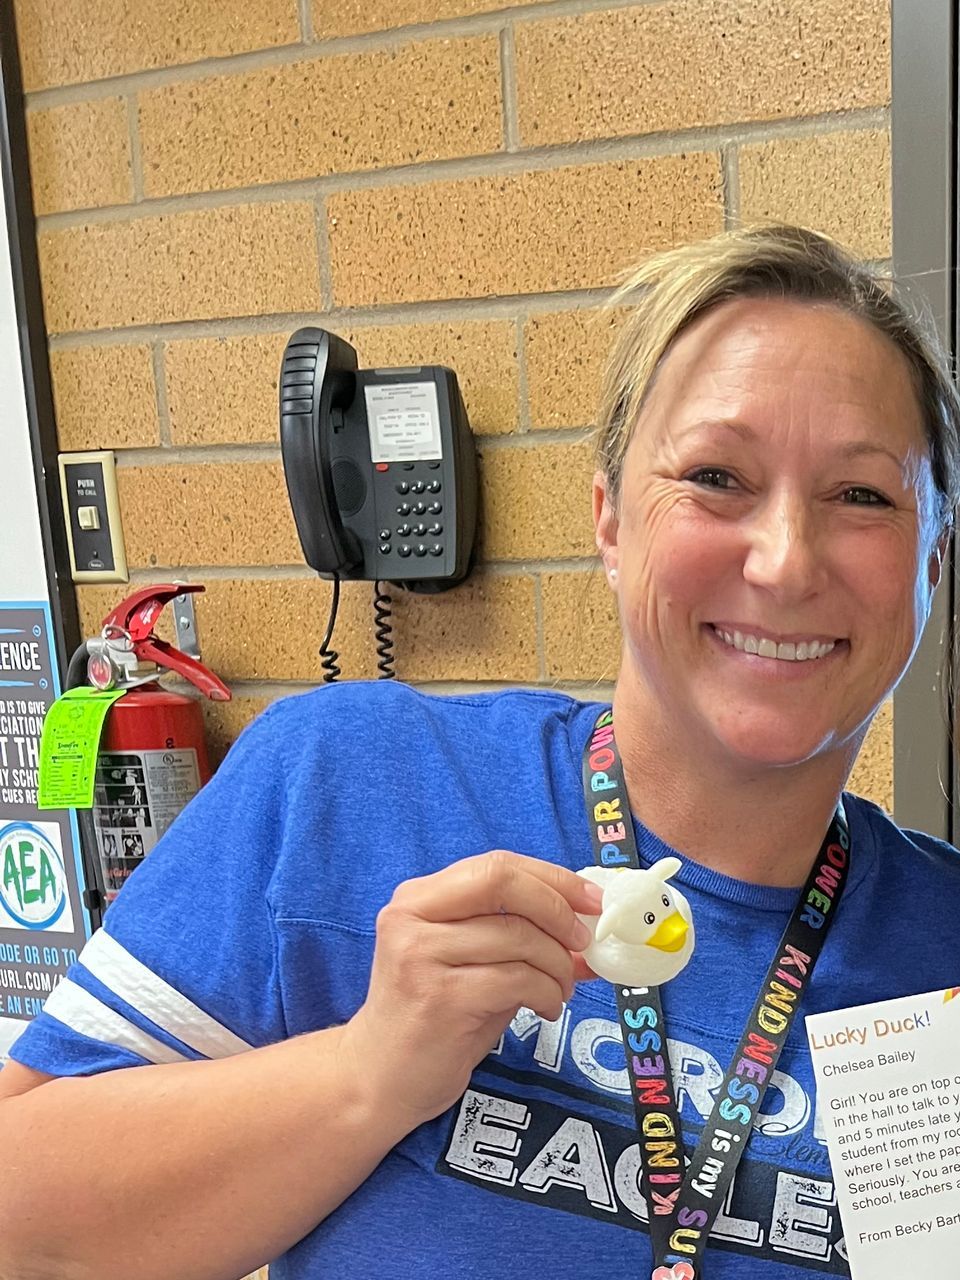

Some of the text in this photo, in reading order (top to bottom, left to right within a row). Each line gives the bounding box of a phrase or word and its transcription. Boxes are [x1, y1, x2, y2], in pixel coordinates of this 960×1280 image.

[0, 642, 41, 671] ENCE
[7, 700, 15, 714] IS
[16, 700, 27, 714] TO
[28, 701, 46, 715] GIVE
[0, 716, 44, 736] CIATION
[13, 737, 40, 768] TH
[13, 768, 39, 788] SCHO
[24, 789, 38, 804] RE
[594, 798, 631, 866] PER
[3, 841, 56, 912] AEA
[24, 945, 40, 965] OR
[43, 946, 59, 967] GO
[61, 948, 77, 966] TO
[0, 968, 64, 992] URL.COM/
[7, 995, 22, 1014] AN
[24, 997, 46, 1016] EM
[719, 944, 811, 1126] KINDNESS
[811, 1010, 931, 1050] Lucky Duck!
[491, 1001, 829, 1147] MORO
[823, 1050, 916, 1077] Chelsea Bailey
[830, 1095, 856, 1110] Girl!
[859, 1092, 885, 1103] You
[888, 1087, 908, 1099] are
[912, 1083, 928, 1094] on
[931, 1077, 951, 1091] top
[624, 1006, 681, 1215] KINDNESS
[833, 1117, 845, 1127] in
[848, 1112, 868, 1124] the
[872, 1106, 894, 1119] hall
[897, 1104, 909, 1115] to
[912, 1098, 935, 1111] talk
[938, 1095, 950, 1106] to
[711, 1128, 741, 1153] is
[838, 1131, 861, 1145] and
[865, 1127, 873, 1139] 5
[876, 1118, 925, 1136] minutes
[928, 1113, 951, 1126] late
[841, 1142, 888, 1161] student
[890, 1137, 918, 1151] from
[922, 1132, 941, 1144] my
[691, 1157, 725, 1199] my
[844, 1162, 883, 1177] where
[887, 1158, 891, 1169] I
[894, 1155, 914, 1168] set
[916, 1150, 936, 1163] the
[848, 1174, 910, 1195] Seriously.
[912, 1168, 938, 1181] You
[941, 1163, 960, 1175] are
[852, 1192, 896, 1211] school,
[899, 1182, 953, 1200] teachers
[859, 1229, 892, 1244] From
[895, 1220, 933, 1237] Becky
